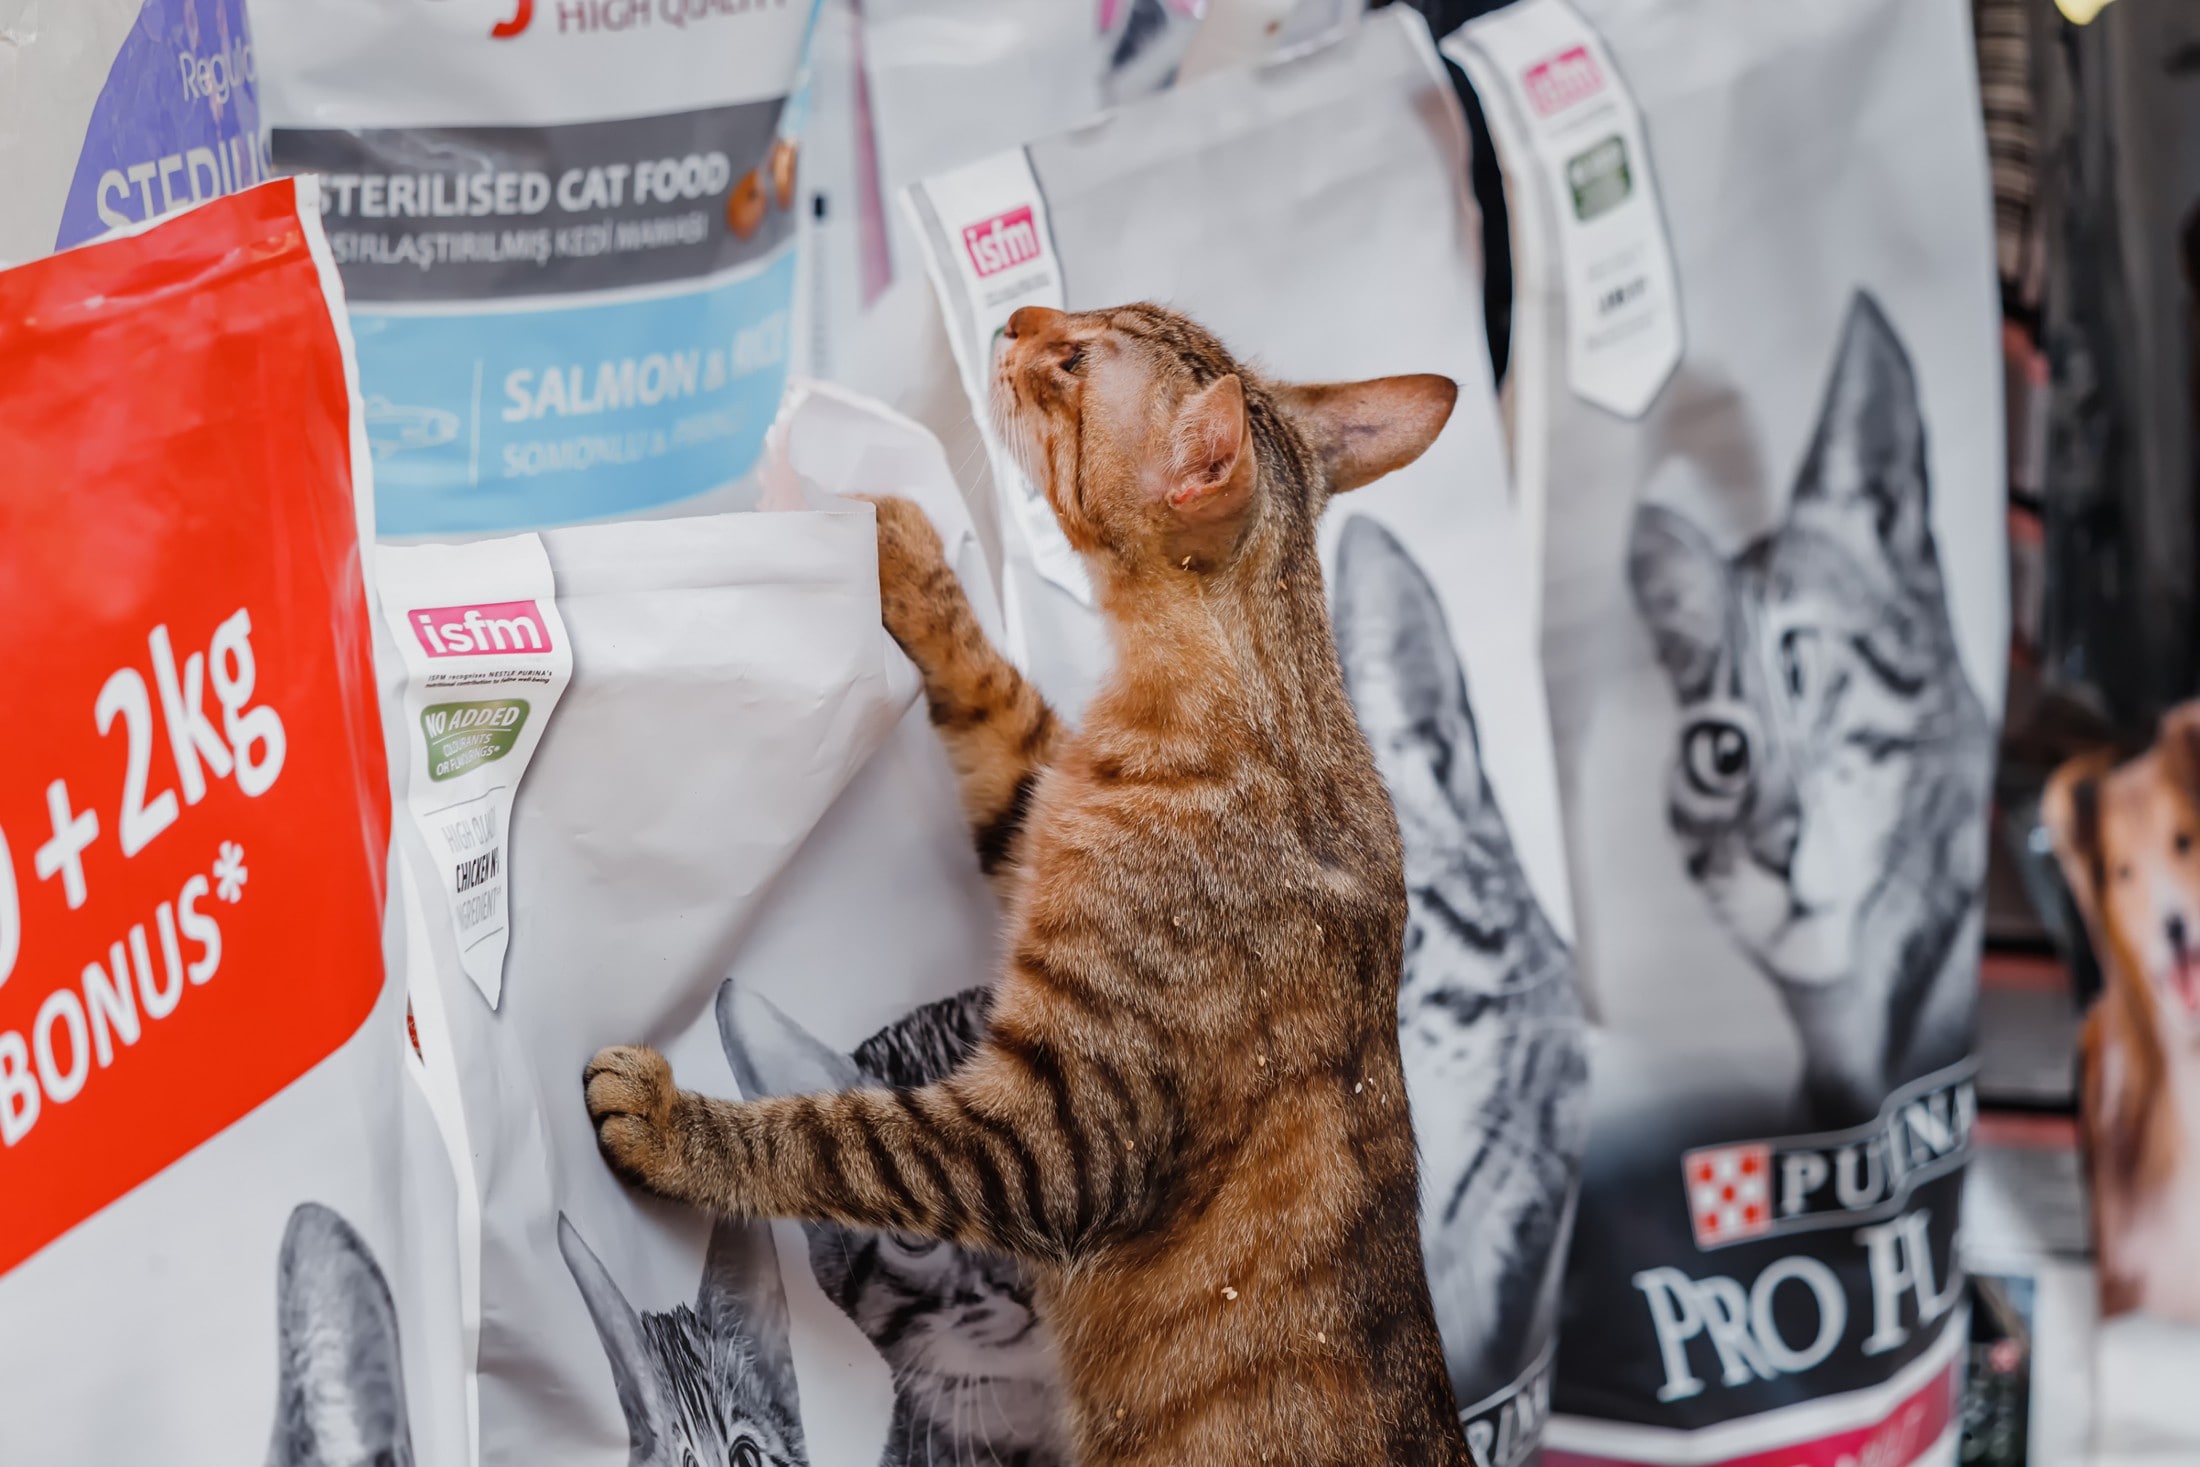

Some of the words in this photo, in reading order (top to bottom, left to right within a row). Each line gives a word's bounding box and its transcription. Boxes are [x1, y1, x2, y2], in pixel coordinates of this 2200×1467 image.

[557, 163, 631, 213] CAT
[634, 151, 731, 205] FOOD
[502, 349, 700, 423] SALMON
[417, 610, 543, 653] isfm
[425, 711, 447, 738] NO
[449, 706, 521, 731] ADDED
[456, 851, 491, 893] CHICKEN
[1632, 1256, 1848, 1403] PRO
